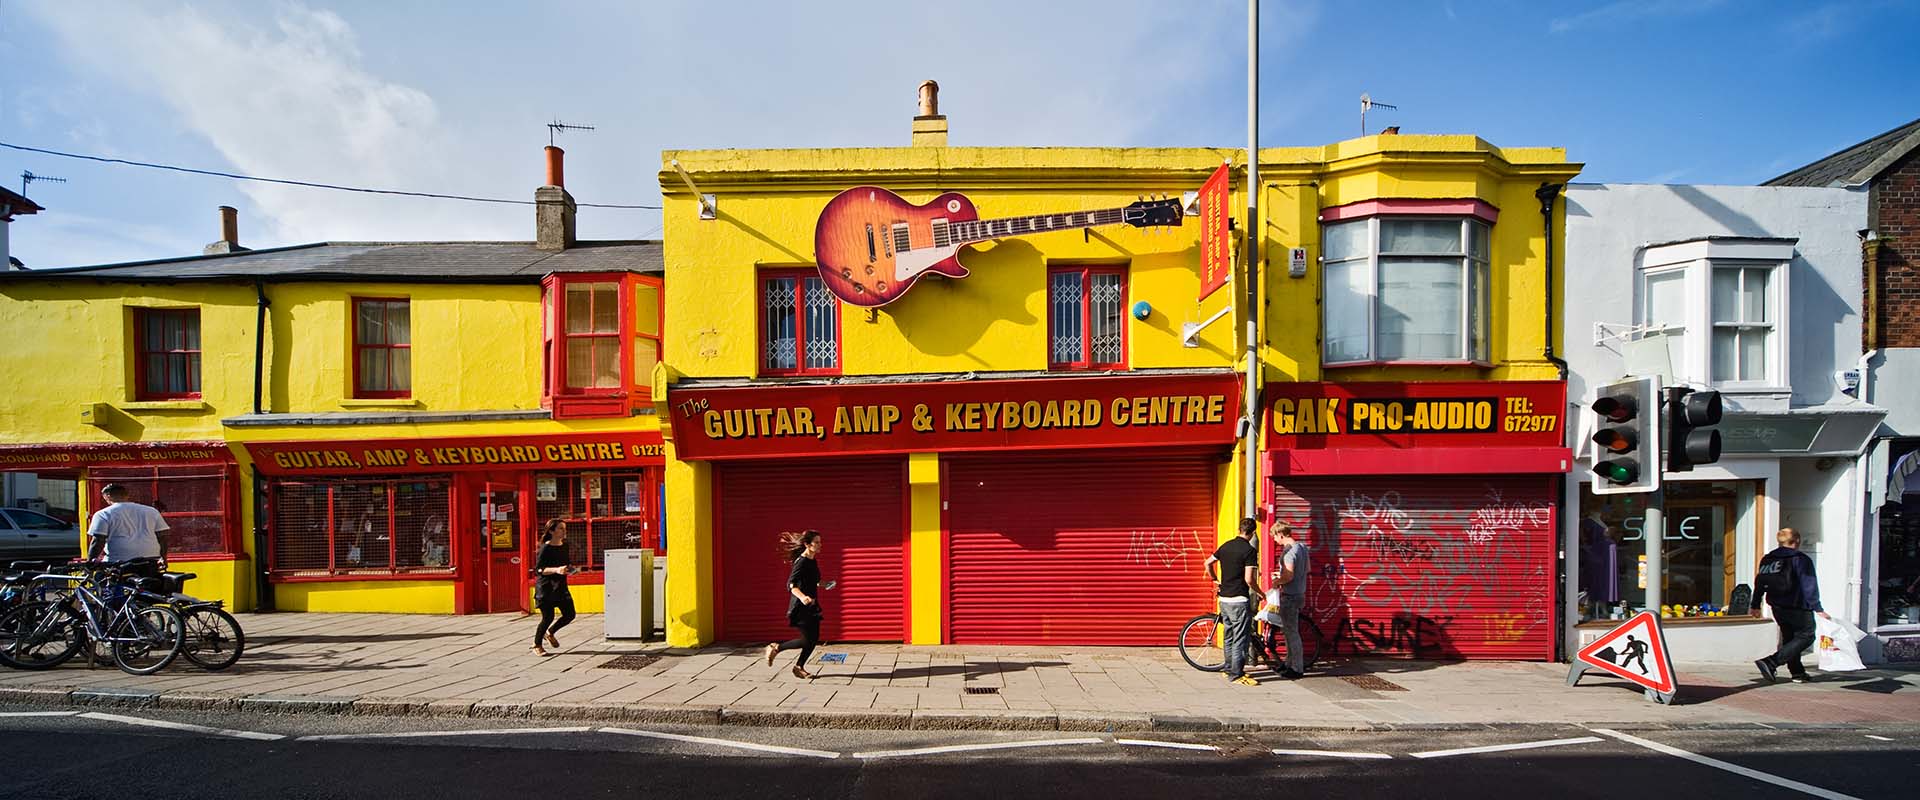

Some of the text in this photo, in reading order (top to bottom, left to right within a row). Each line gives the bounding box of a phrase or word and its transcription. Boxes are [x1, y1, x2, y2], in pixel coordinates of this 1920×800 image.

[678, 396, 710, 419] The
[1273, 398, 1491, 434] GAK PRO-AUDIO
[1505, 397, 1533, 414] TEL:
[703, 395, 1225, 440] GUITAR, AMP & KEYBOARD CENTRE
[1504, 415, 1556, 432] 672977
[76, 453, 135, 462] MUSICAL
[143, 450, 216, 460] EQUIPMENT
[274, 442, 665, 469] GUITAR, AMP & KEYBOARD CENTRE 01273
[1623, 516, 1700, 540] SLE
